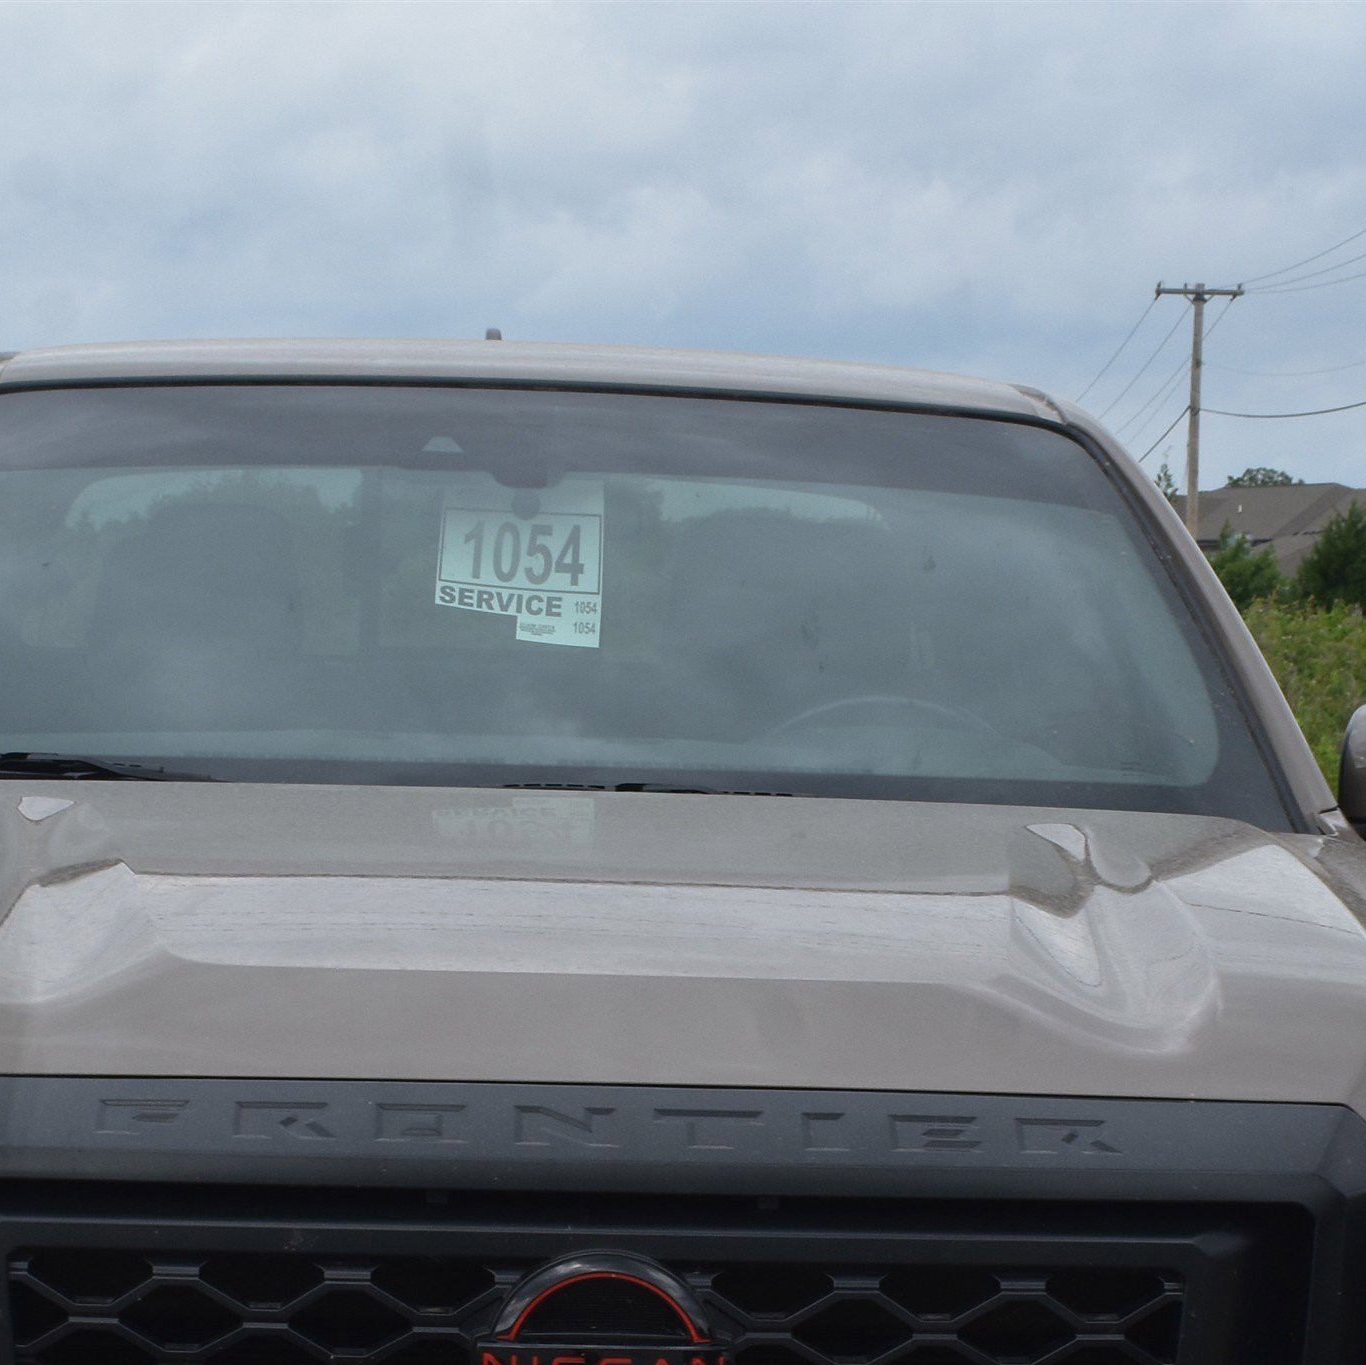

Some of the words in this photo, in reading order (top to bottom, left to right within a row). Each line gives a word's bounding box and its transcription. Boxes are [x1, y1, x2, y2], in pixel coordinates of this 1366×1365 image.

[464, 521, 585, 586] 1054
[439, 586, 563, 617] SERVICE
[574, 601, 598, 615] 1054
[572, 622, 596, 635] 1054
[98, 1098, 1125, 1155] FRONTIER
